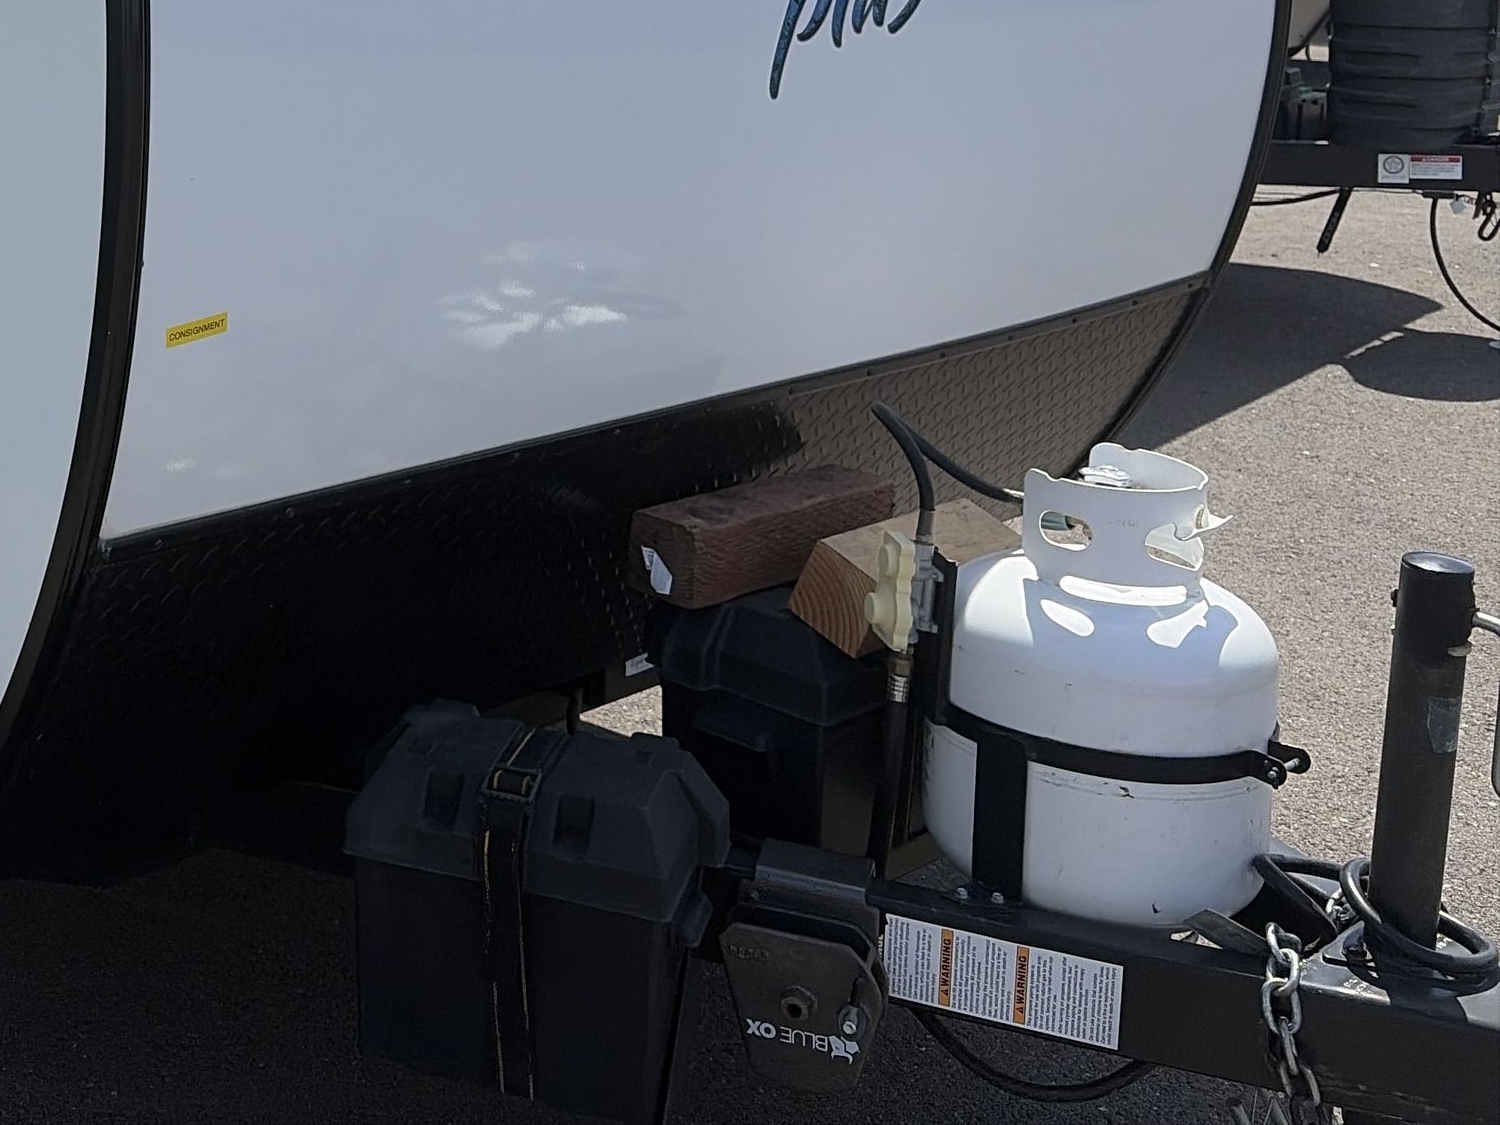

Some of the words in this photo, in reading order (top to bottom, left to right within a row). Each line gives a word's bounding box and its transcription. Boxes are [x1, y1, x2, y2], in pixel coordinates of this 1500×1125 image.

[168, 318, 226, 342] CONSIGNMENT
[939, 938, 953, 987] WARNING
[1015, 955, 1028, 1004] WARNING
[746, 1018, 777, 1039] OX
[780, 1026, 828, 1052] BLUE
